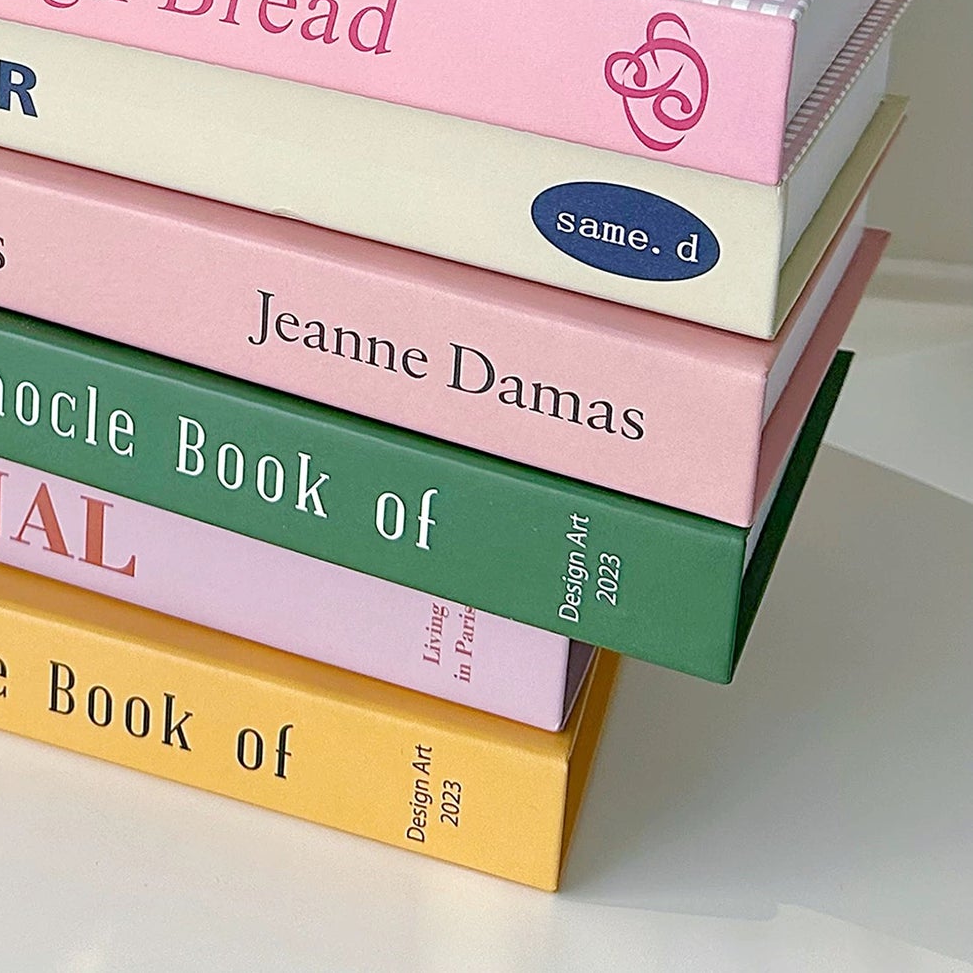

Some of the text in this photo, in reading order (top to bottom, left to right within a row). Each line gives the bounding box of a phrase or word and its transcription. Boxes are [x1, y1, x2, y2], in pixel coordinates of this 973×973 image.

[556, 211, 699, 264] same. d
[248, 289, 646, 443] Jeanne Damas
[175, 440, 331, 519] Book
[375, 487, 439, 552] of
[558, 513, 591, 623] Design Art
[595, 552, 621, 607] 2023
[423, 603, 450, 666] Living
[453, 663, 471, 684] in
[47, 660, 195, 753] Book
[235, 724, 294, 781] of
[406, 744, 434, 843] Design Art
[440, 779, 462, 828] 2023
